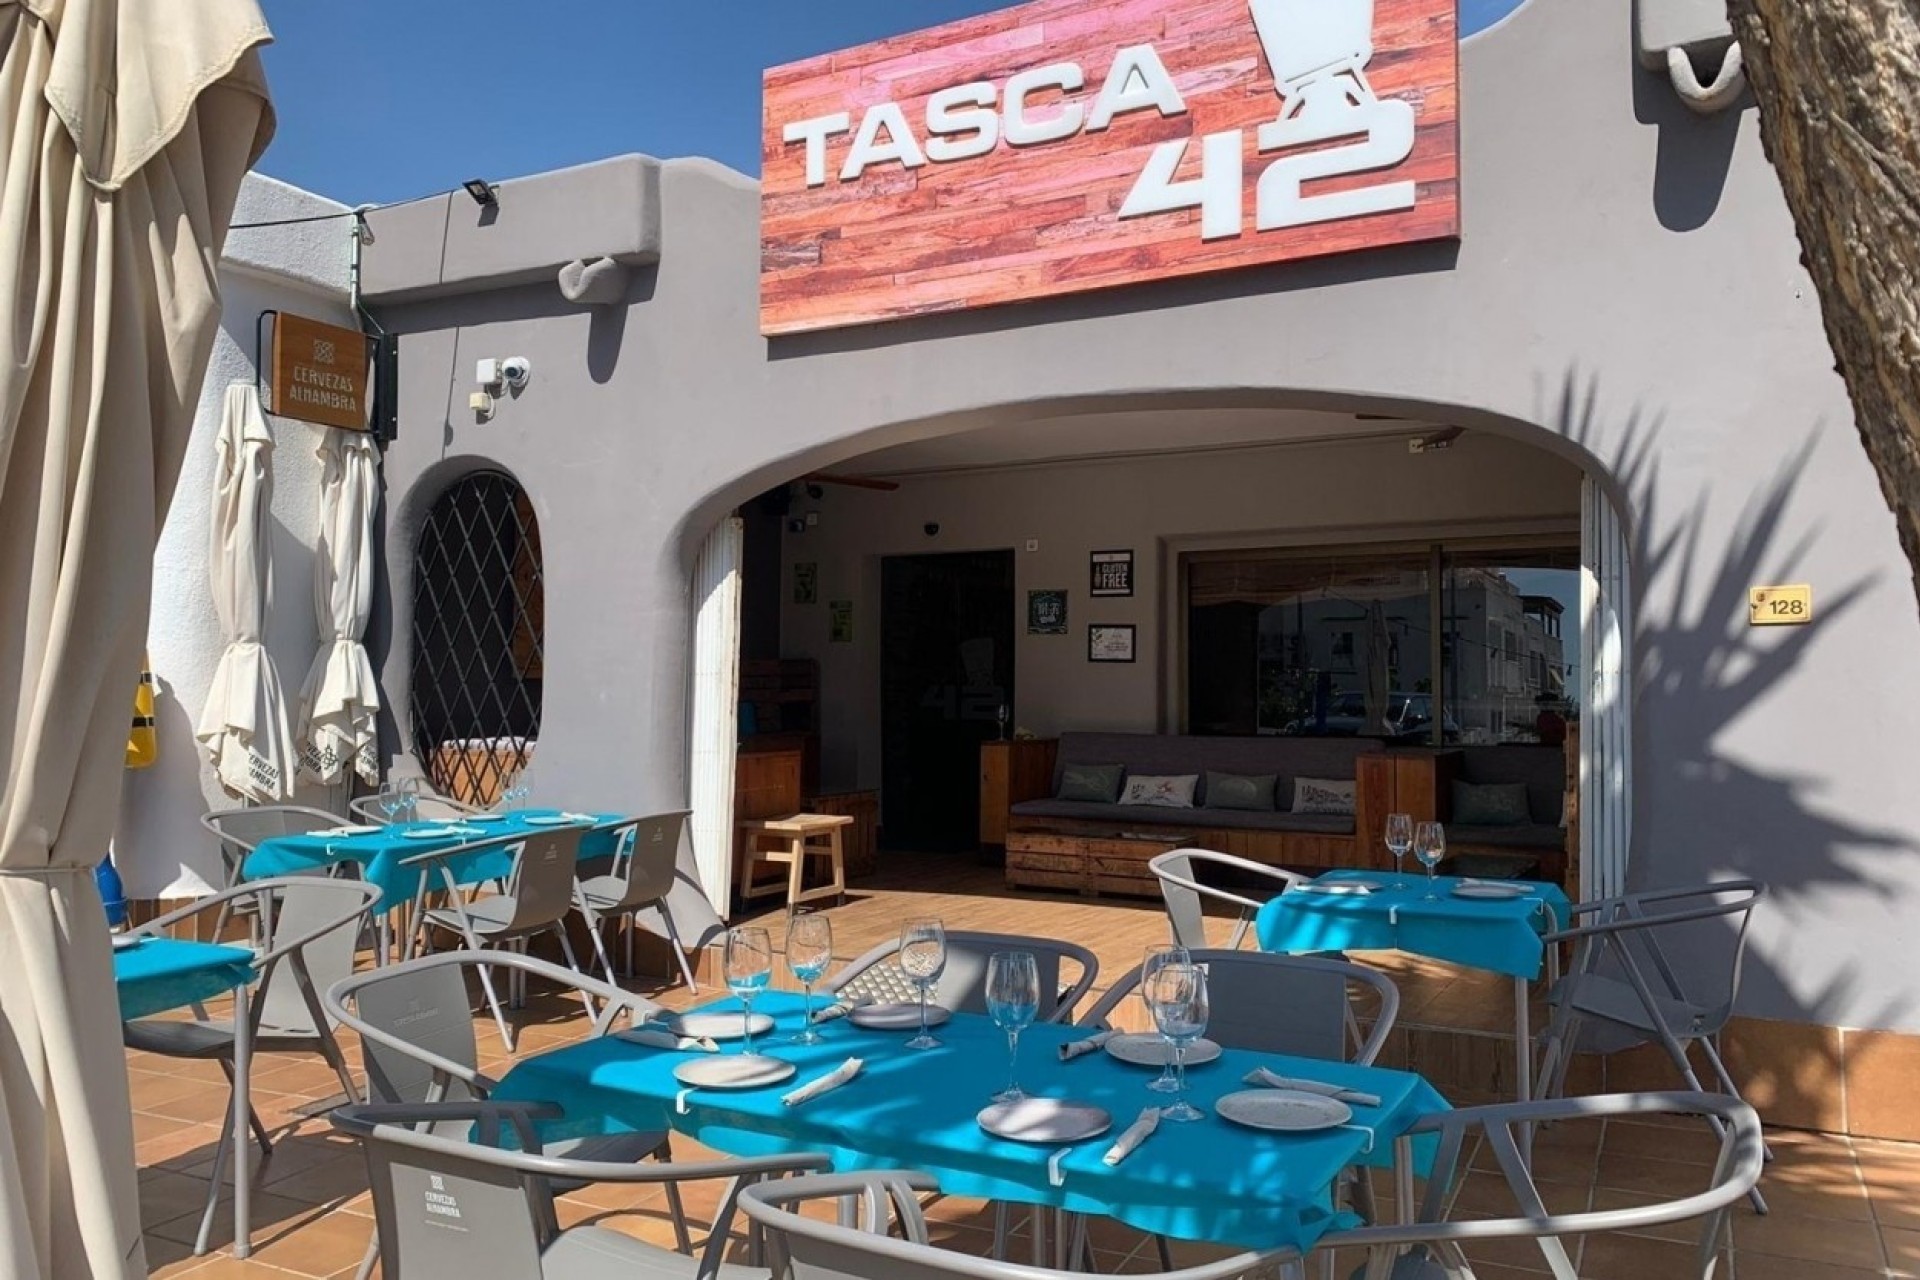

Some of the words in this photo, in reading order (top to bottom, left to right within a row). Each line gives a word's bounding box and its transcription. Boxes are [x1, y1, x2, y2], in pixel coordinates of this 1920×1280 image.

[783, 42, 1187, 188] TASCA
[1118, 99, 1415, 239] 42
[294, 366, 353, 392] CERVEZAS
[290, 385, 356, 411] ALHAMBRA
[1103, 574, 1128, 587] FREE
[1769, 600, 1803, 614] 128
[424, 1191, 456, 1206] CERVEZAS
